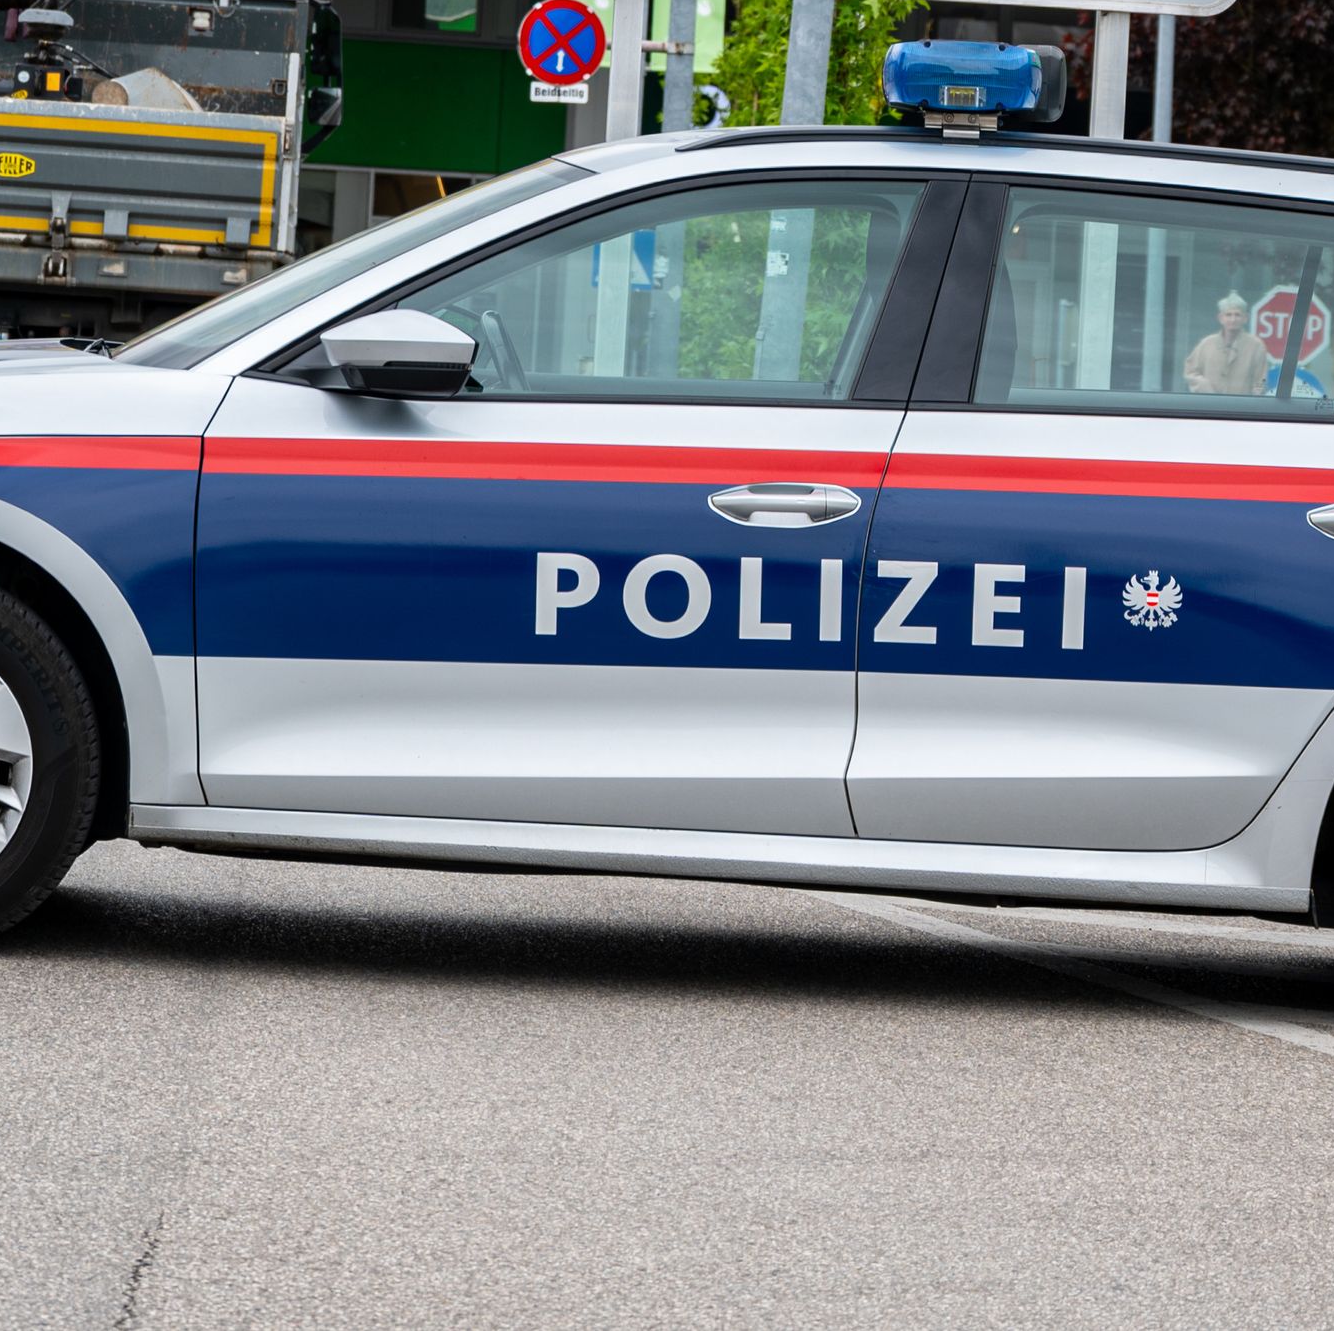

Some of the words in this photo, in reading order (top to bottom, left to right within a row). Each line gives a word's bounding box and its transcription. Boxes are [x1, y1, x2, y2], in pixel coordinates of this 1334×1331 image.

[534, 85, 585, 100] Beidseitig
[1258, 311, 1323, 341] STP
[533, 551, 1088, 651] POLIZEI
